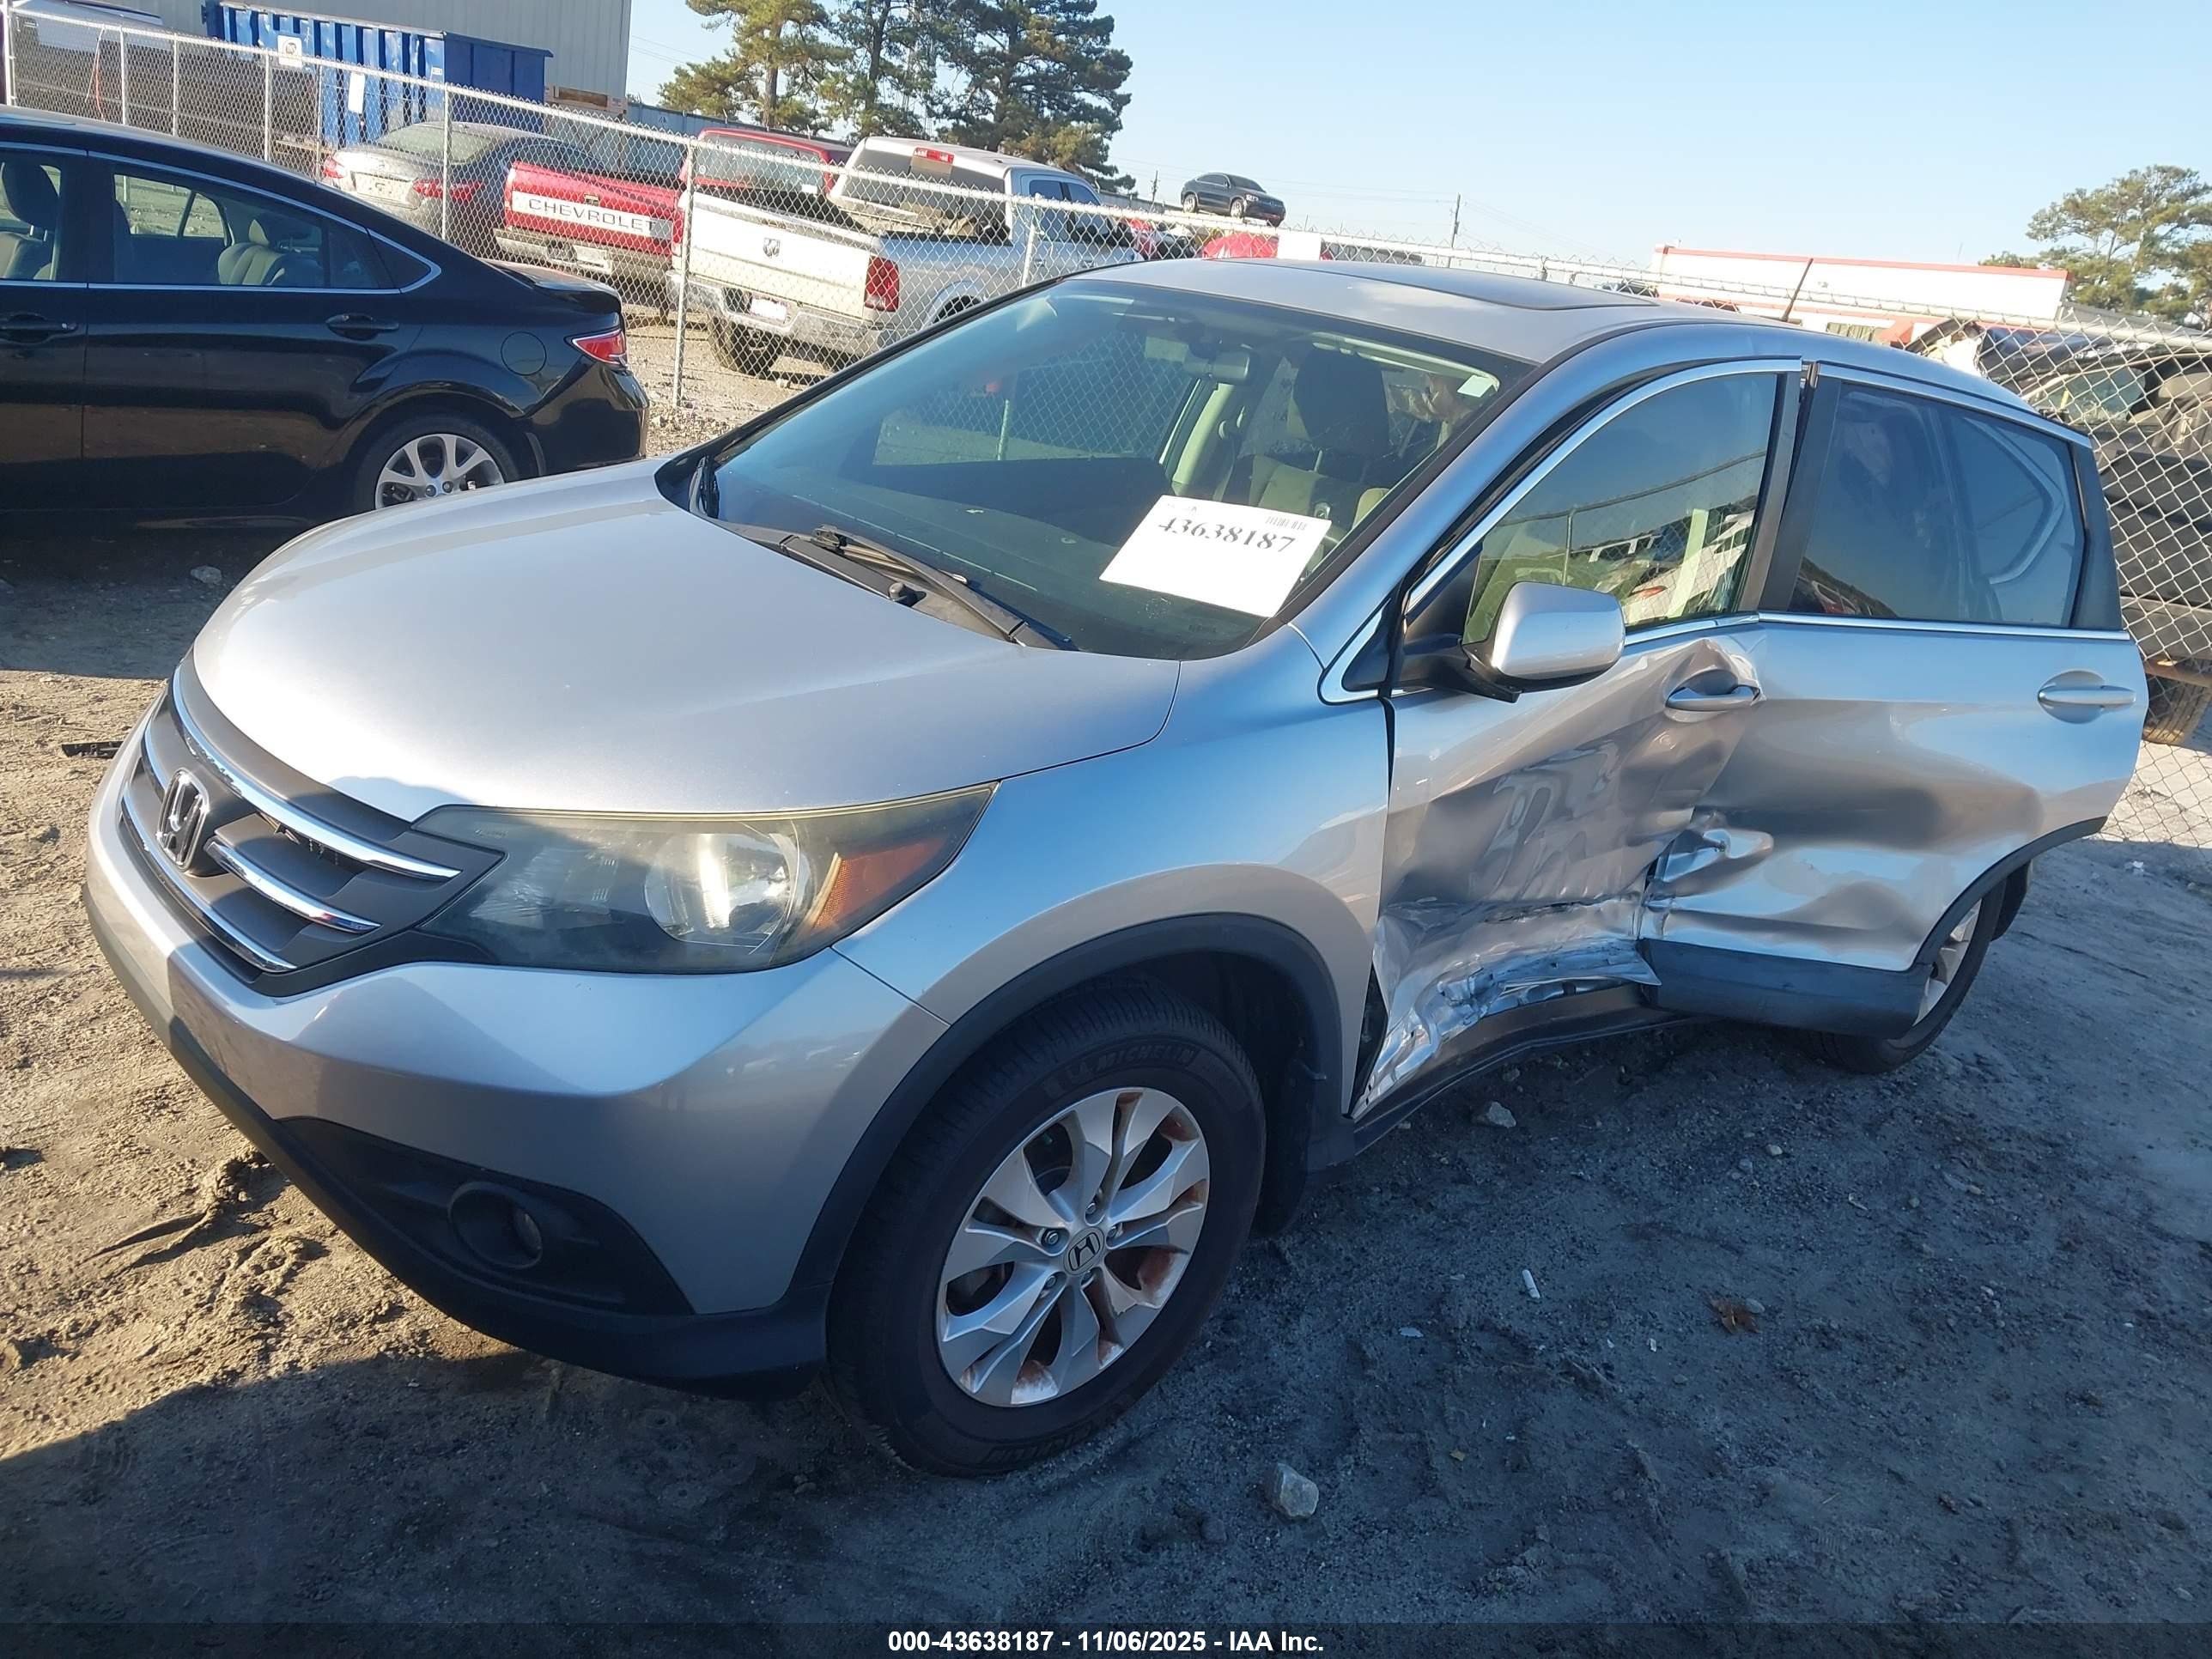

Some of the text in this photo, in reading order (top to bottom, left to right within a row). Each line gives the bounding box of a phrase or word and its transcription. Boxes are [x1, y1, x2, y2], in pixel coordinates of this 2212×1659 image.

[529, 198, 657, 232] CHEVROLET
[1158, 517, 1297, 553] 43638187
[1095, 1044, 1197, 1073] MICHELIN
